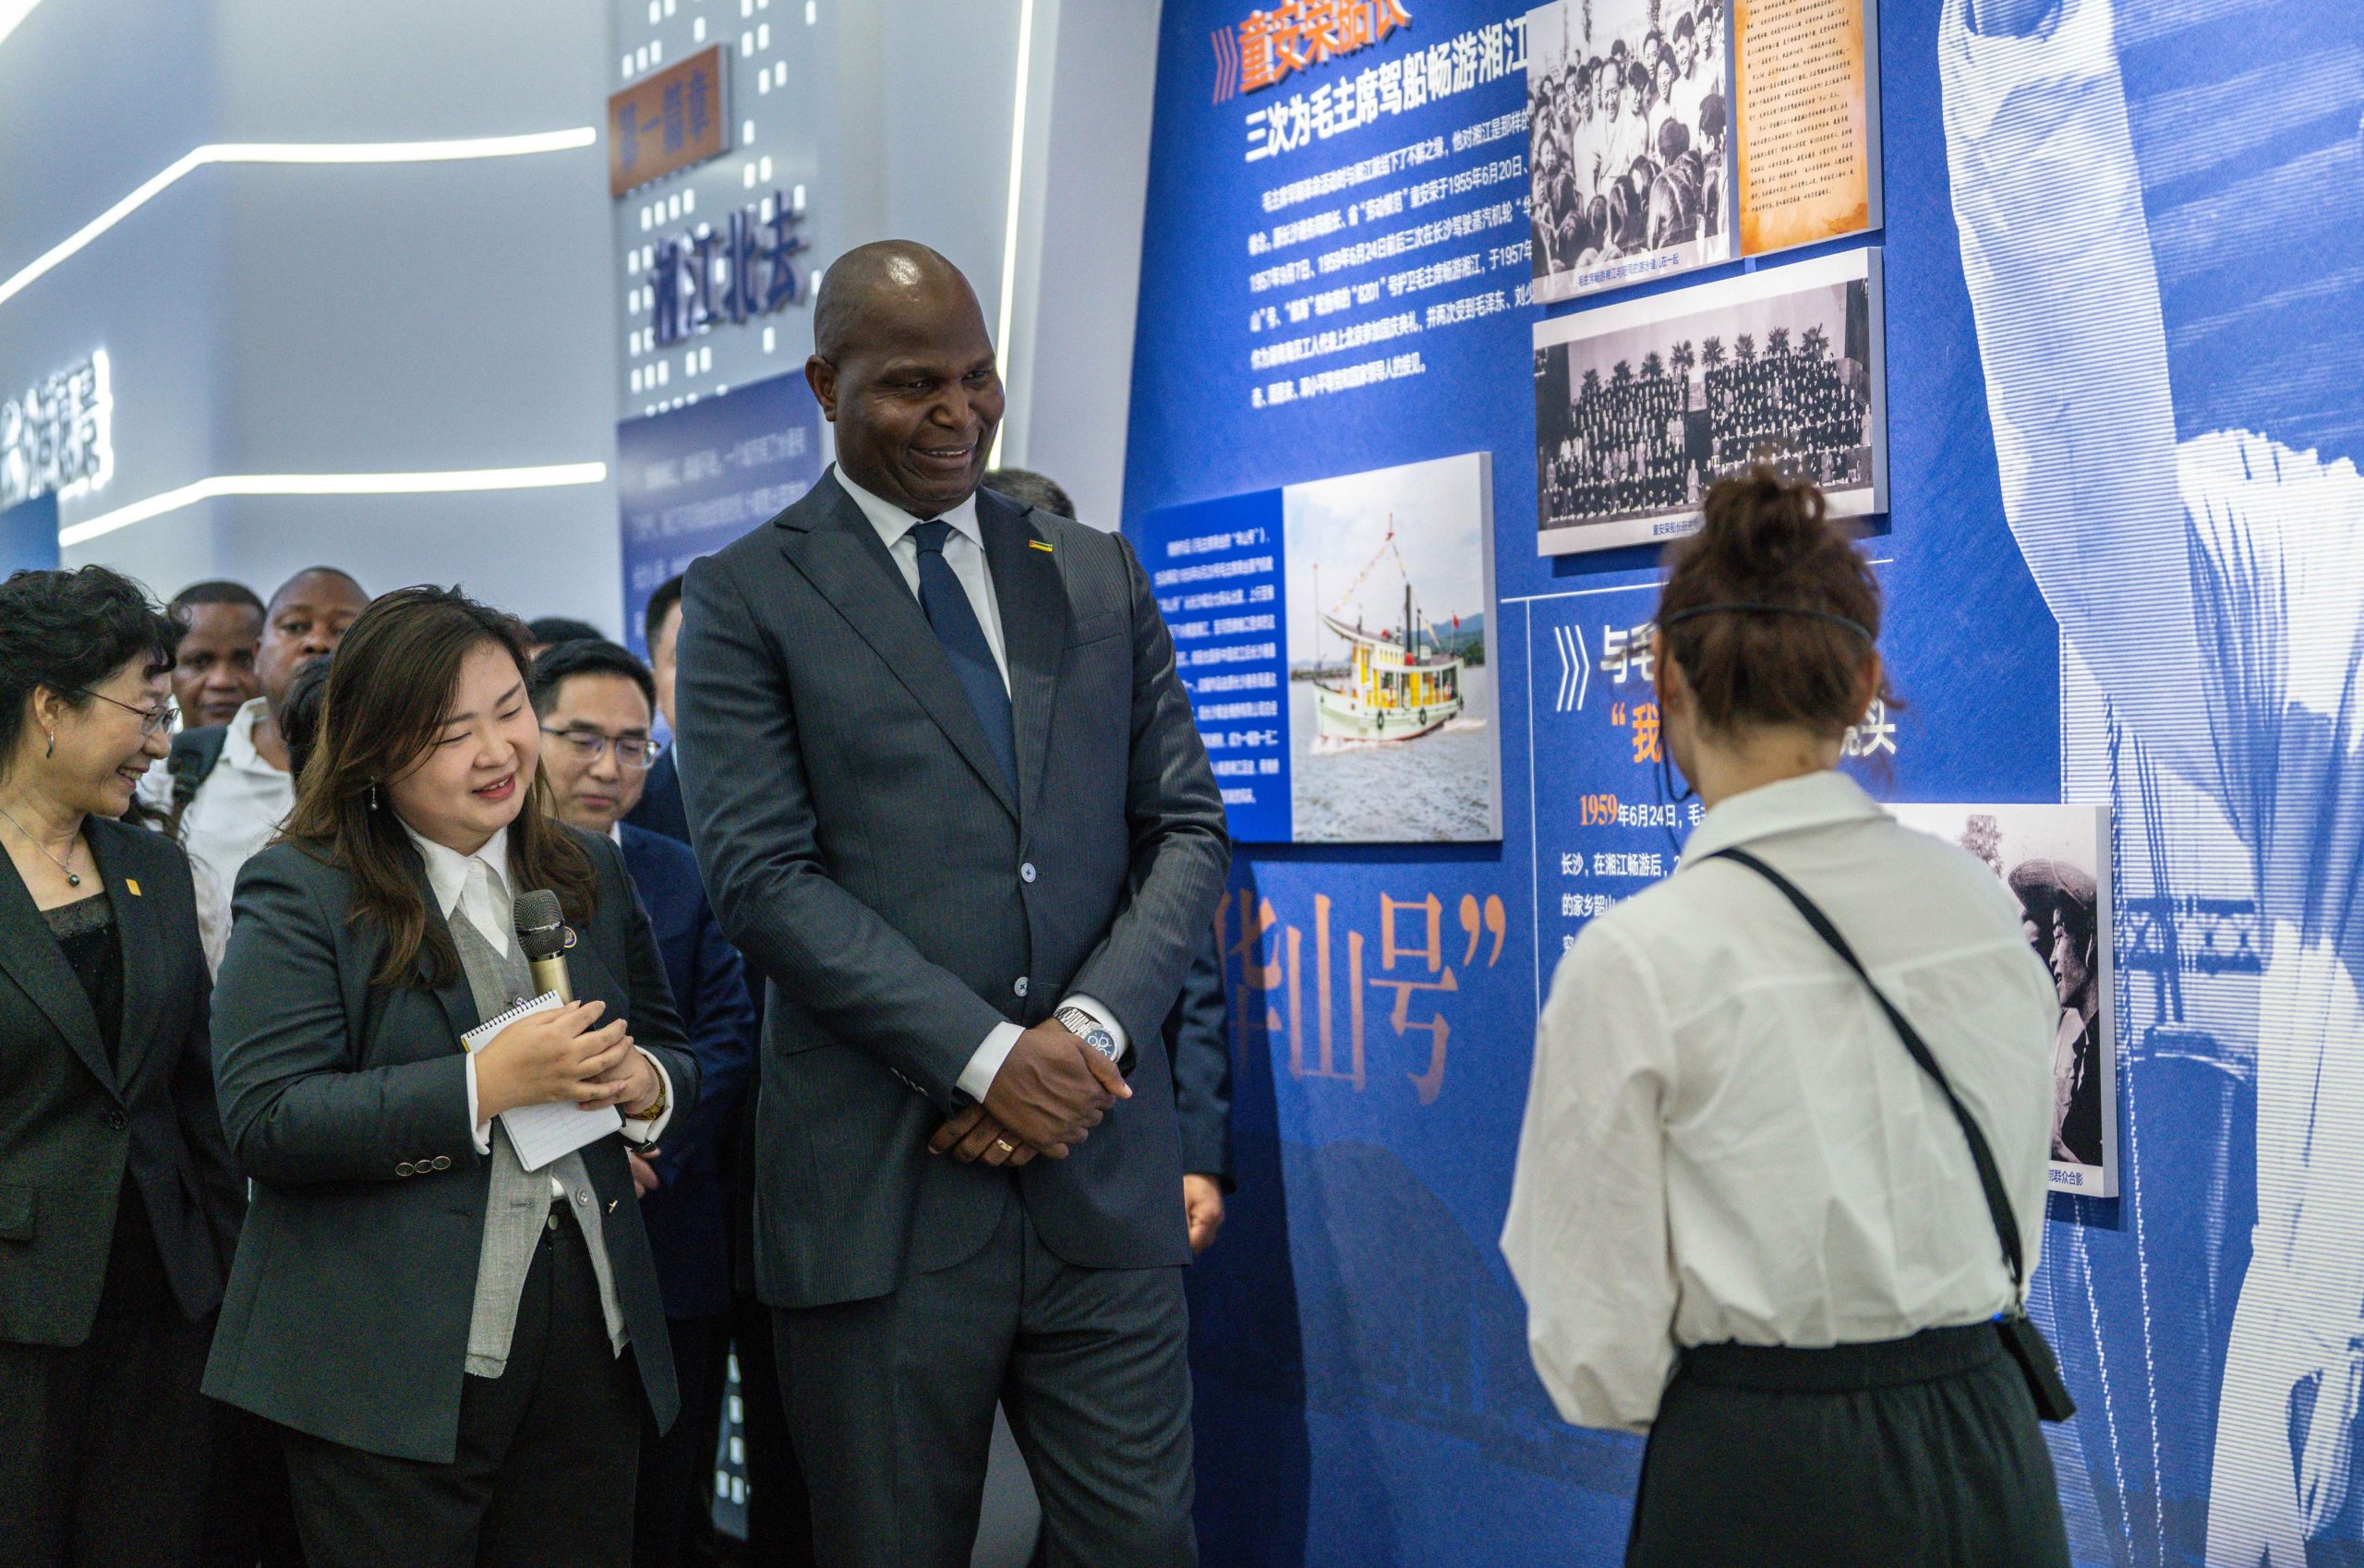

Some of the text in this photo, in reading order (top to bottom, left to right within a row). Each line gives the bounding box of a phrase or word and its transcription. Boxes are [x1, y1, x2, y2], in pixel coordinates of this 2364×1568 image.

[1245, 18, 1528, 162] 三次为毛主席驾船畅游湘江
